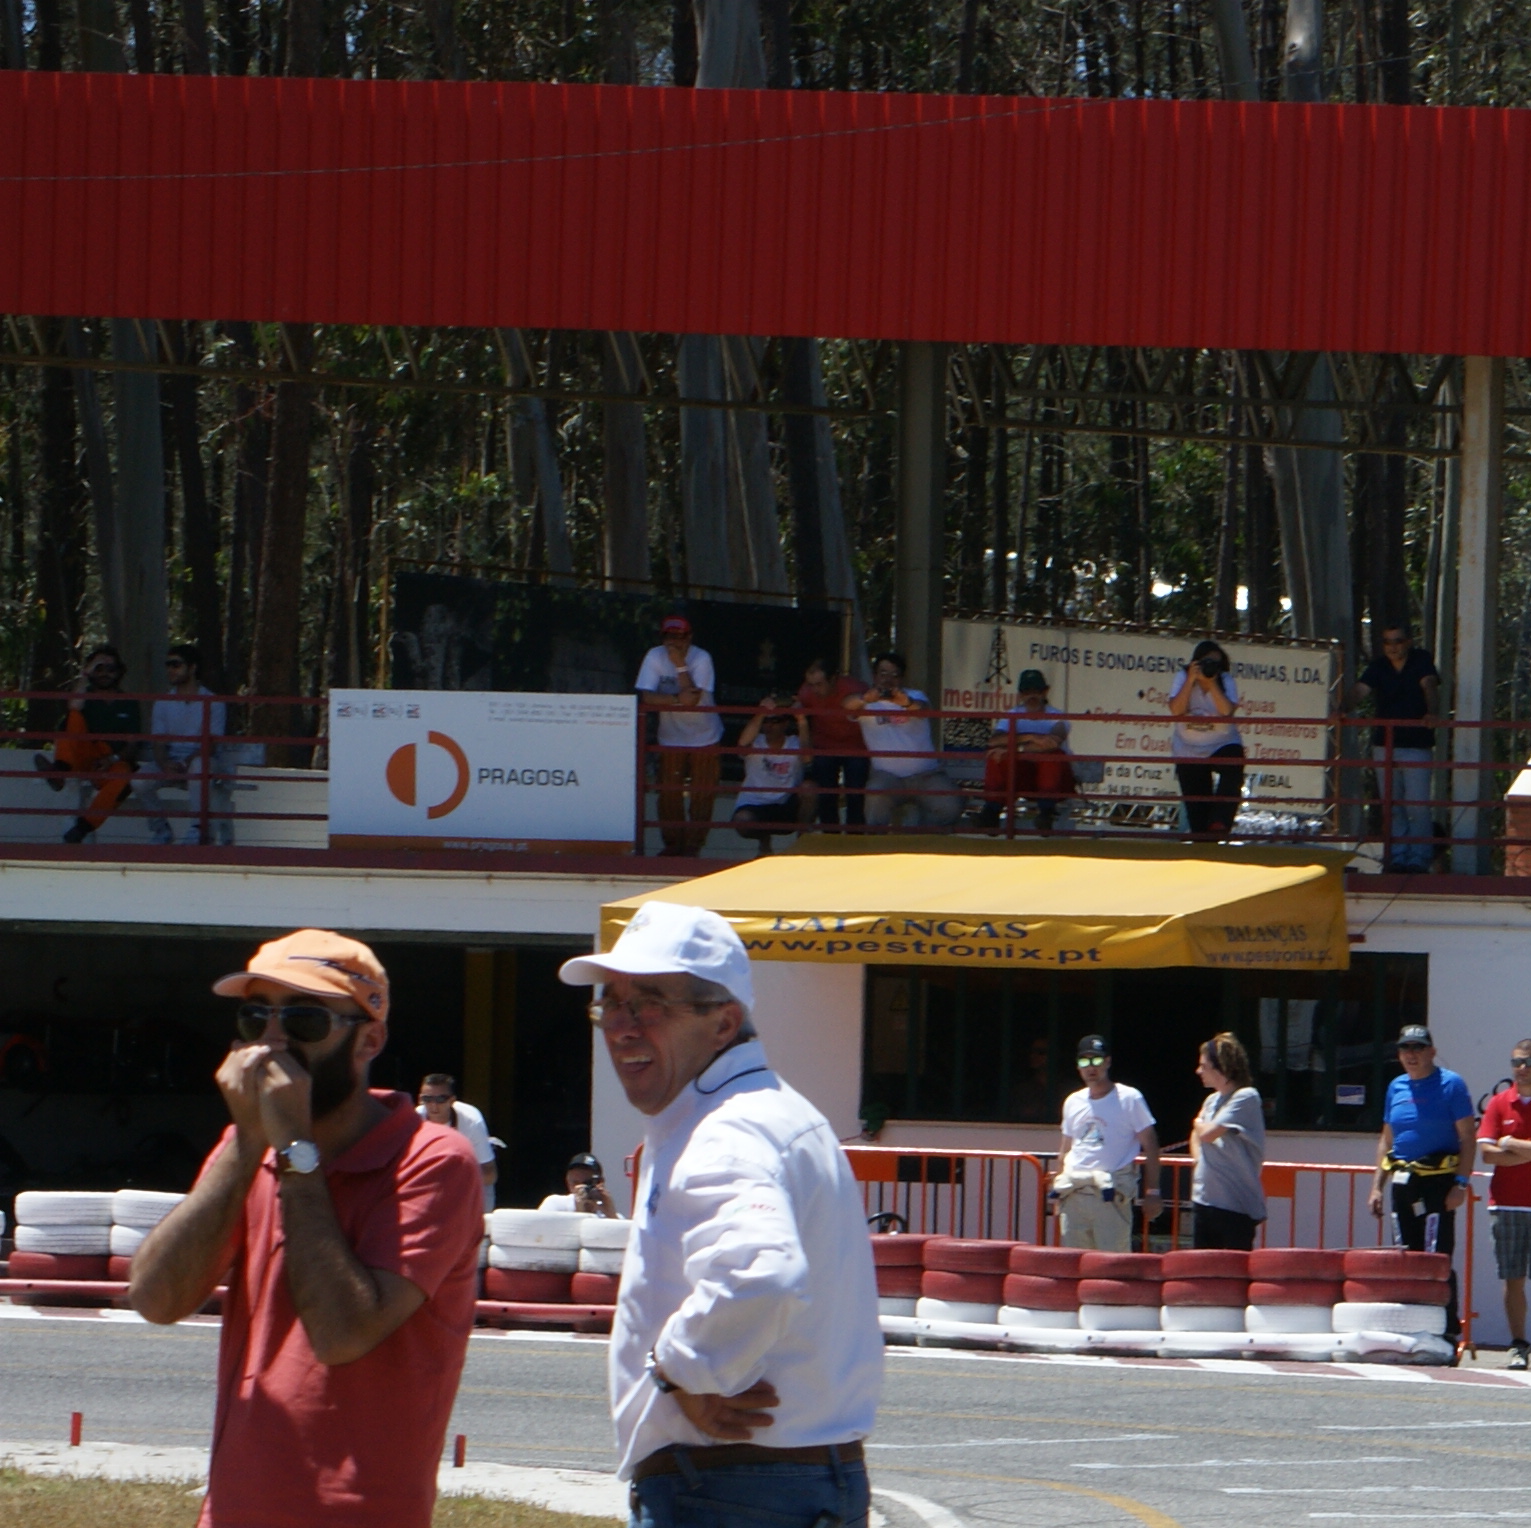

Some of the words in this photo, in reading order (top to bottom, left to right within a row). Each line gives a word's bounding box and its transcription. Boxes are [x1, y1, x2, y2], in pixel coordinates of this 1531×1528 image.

[1030, 642, 1080, 665] FUROS
[1083, 650, 1092, 666] E
[1096, 651, 1187, 674] SONDAGENS
[1230, 661, 1290, 685] IRINHAS,
[1293, 667, 1325, 685] LDA.
[1116, 732, 1136, 749] Em
[477, 767, 579, 787] PRAGOSA
[770, 915, 1028, 941] BALANÇAS
[1225, 925, 1309, 946] BALANÇAS
[741, 938, 1102, 964] ww.pestronix.pt
